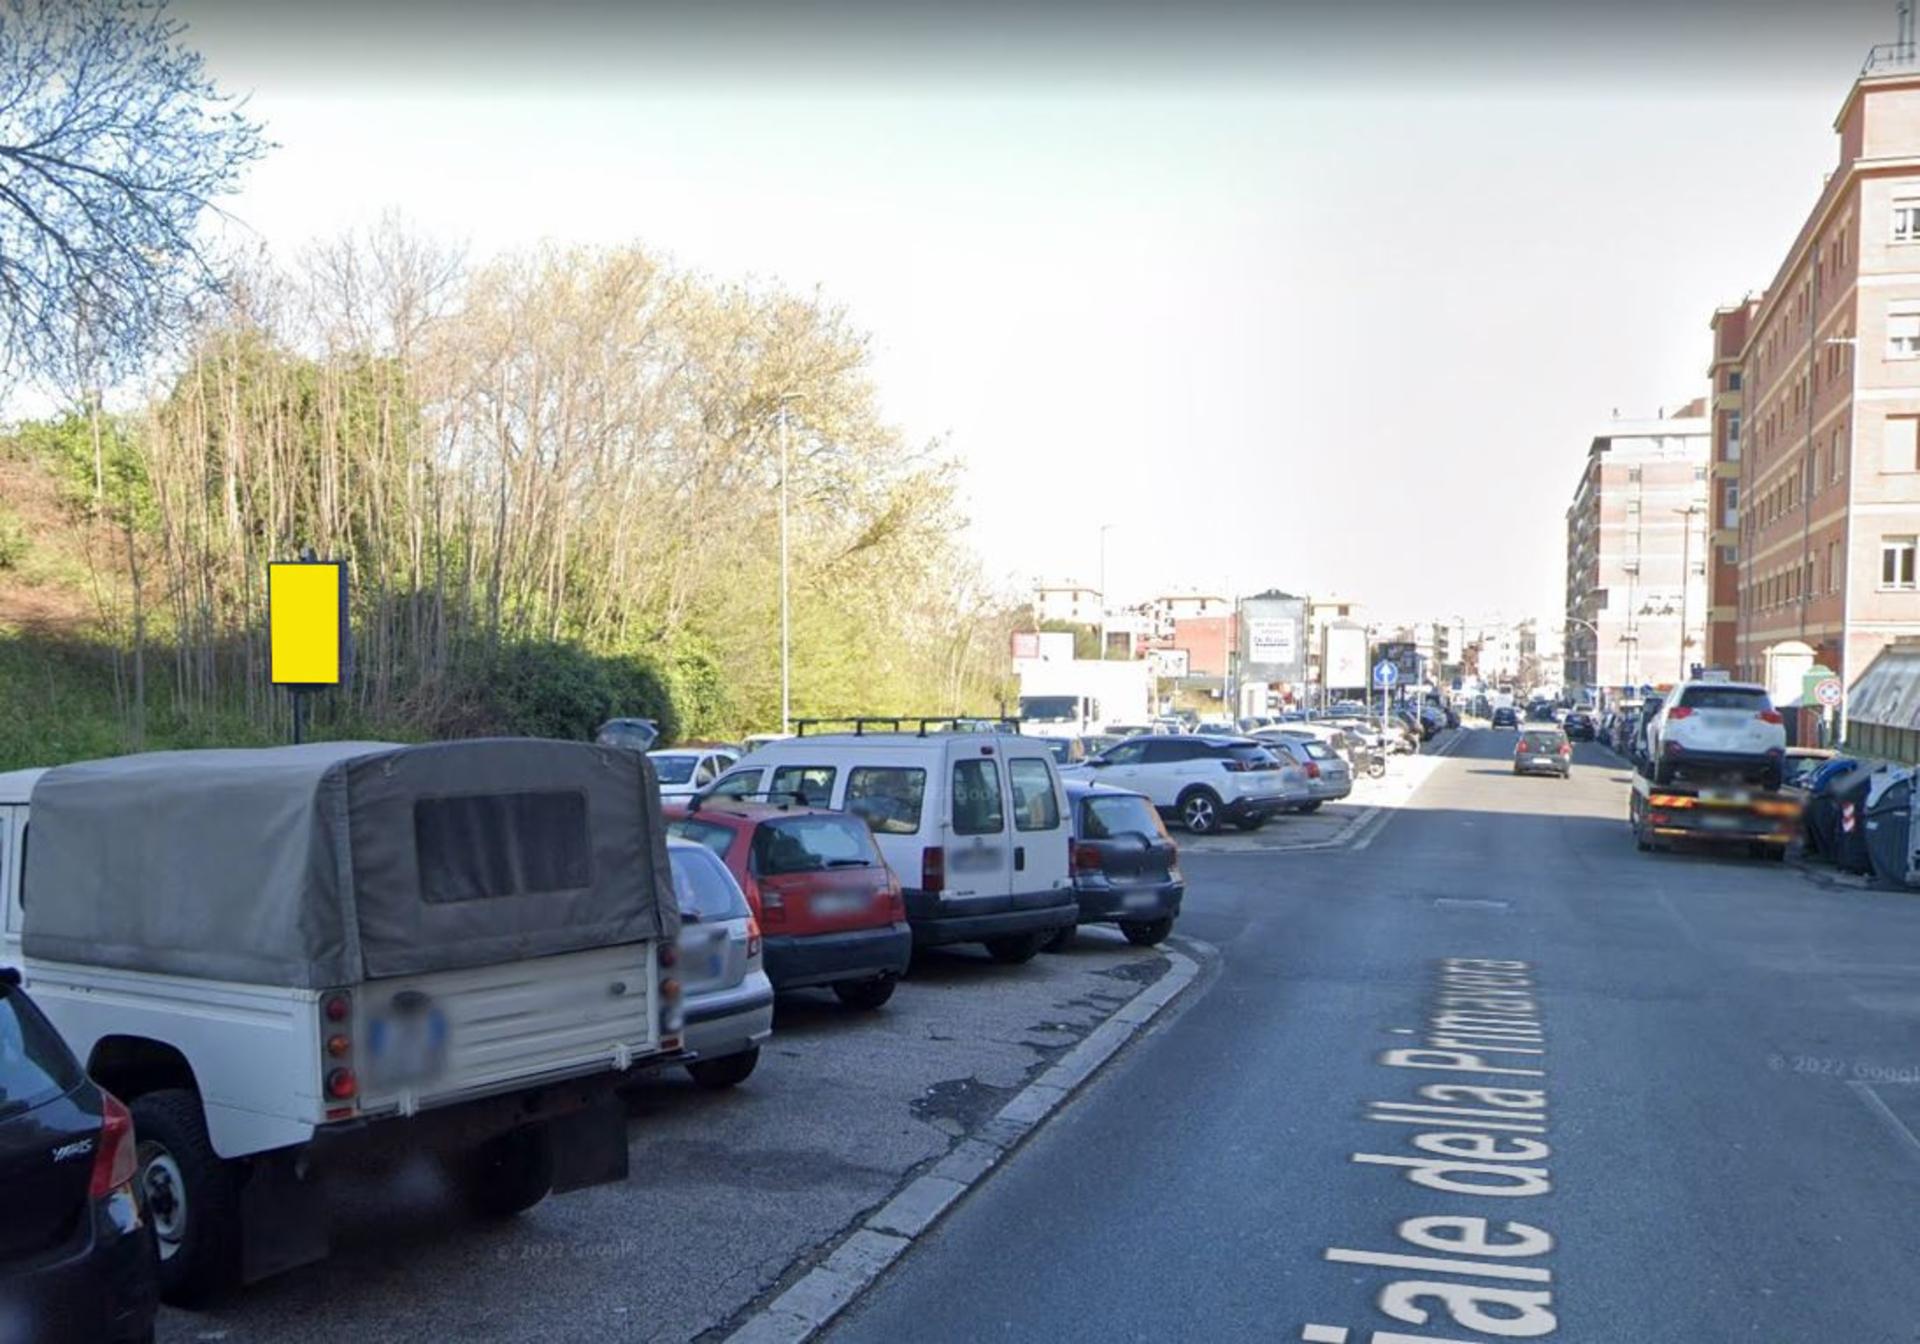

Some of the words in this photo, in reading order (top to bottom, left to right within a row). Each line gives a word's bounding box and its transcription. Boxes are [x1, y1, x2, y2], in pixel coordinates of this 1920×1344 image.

[1378, 958, 1545, 1076] Primavera
[52, 1138, 93, 1163] YARIS
[1353, 1084, 1550, 1196] della
